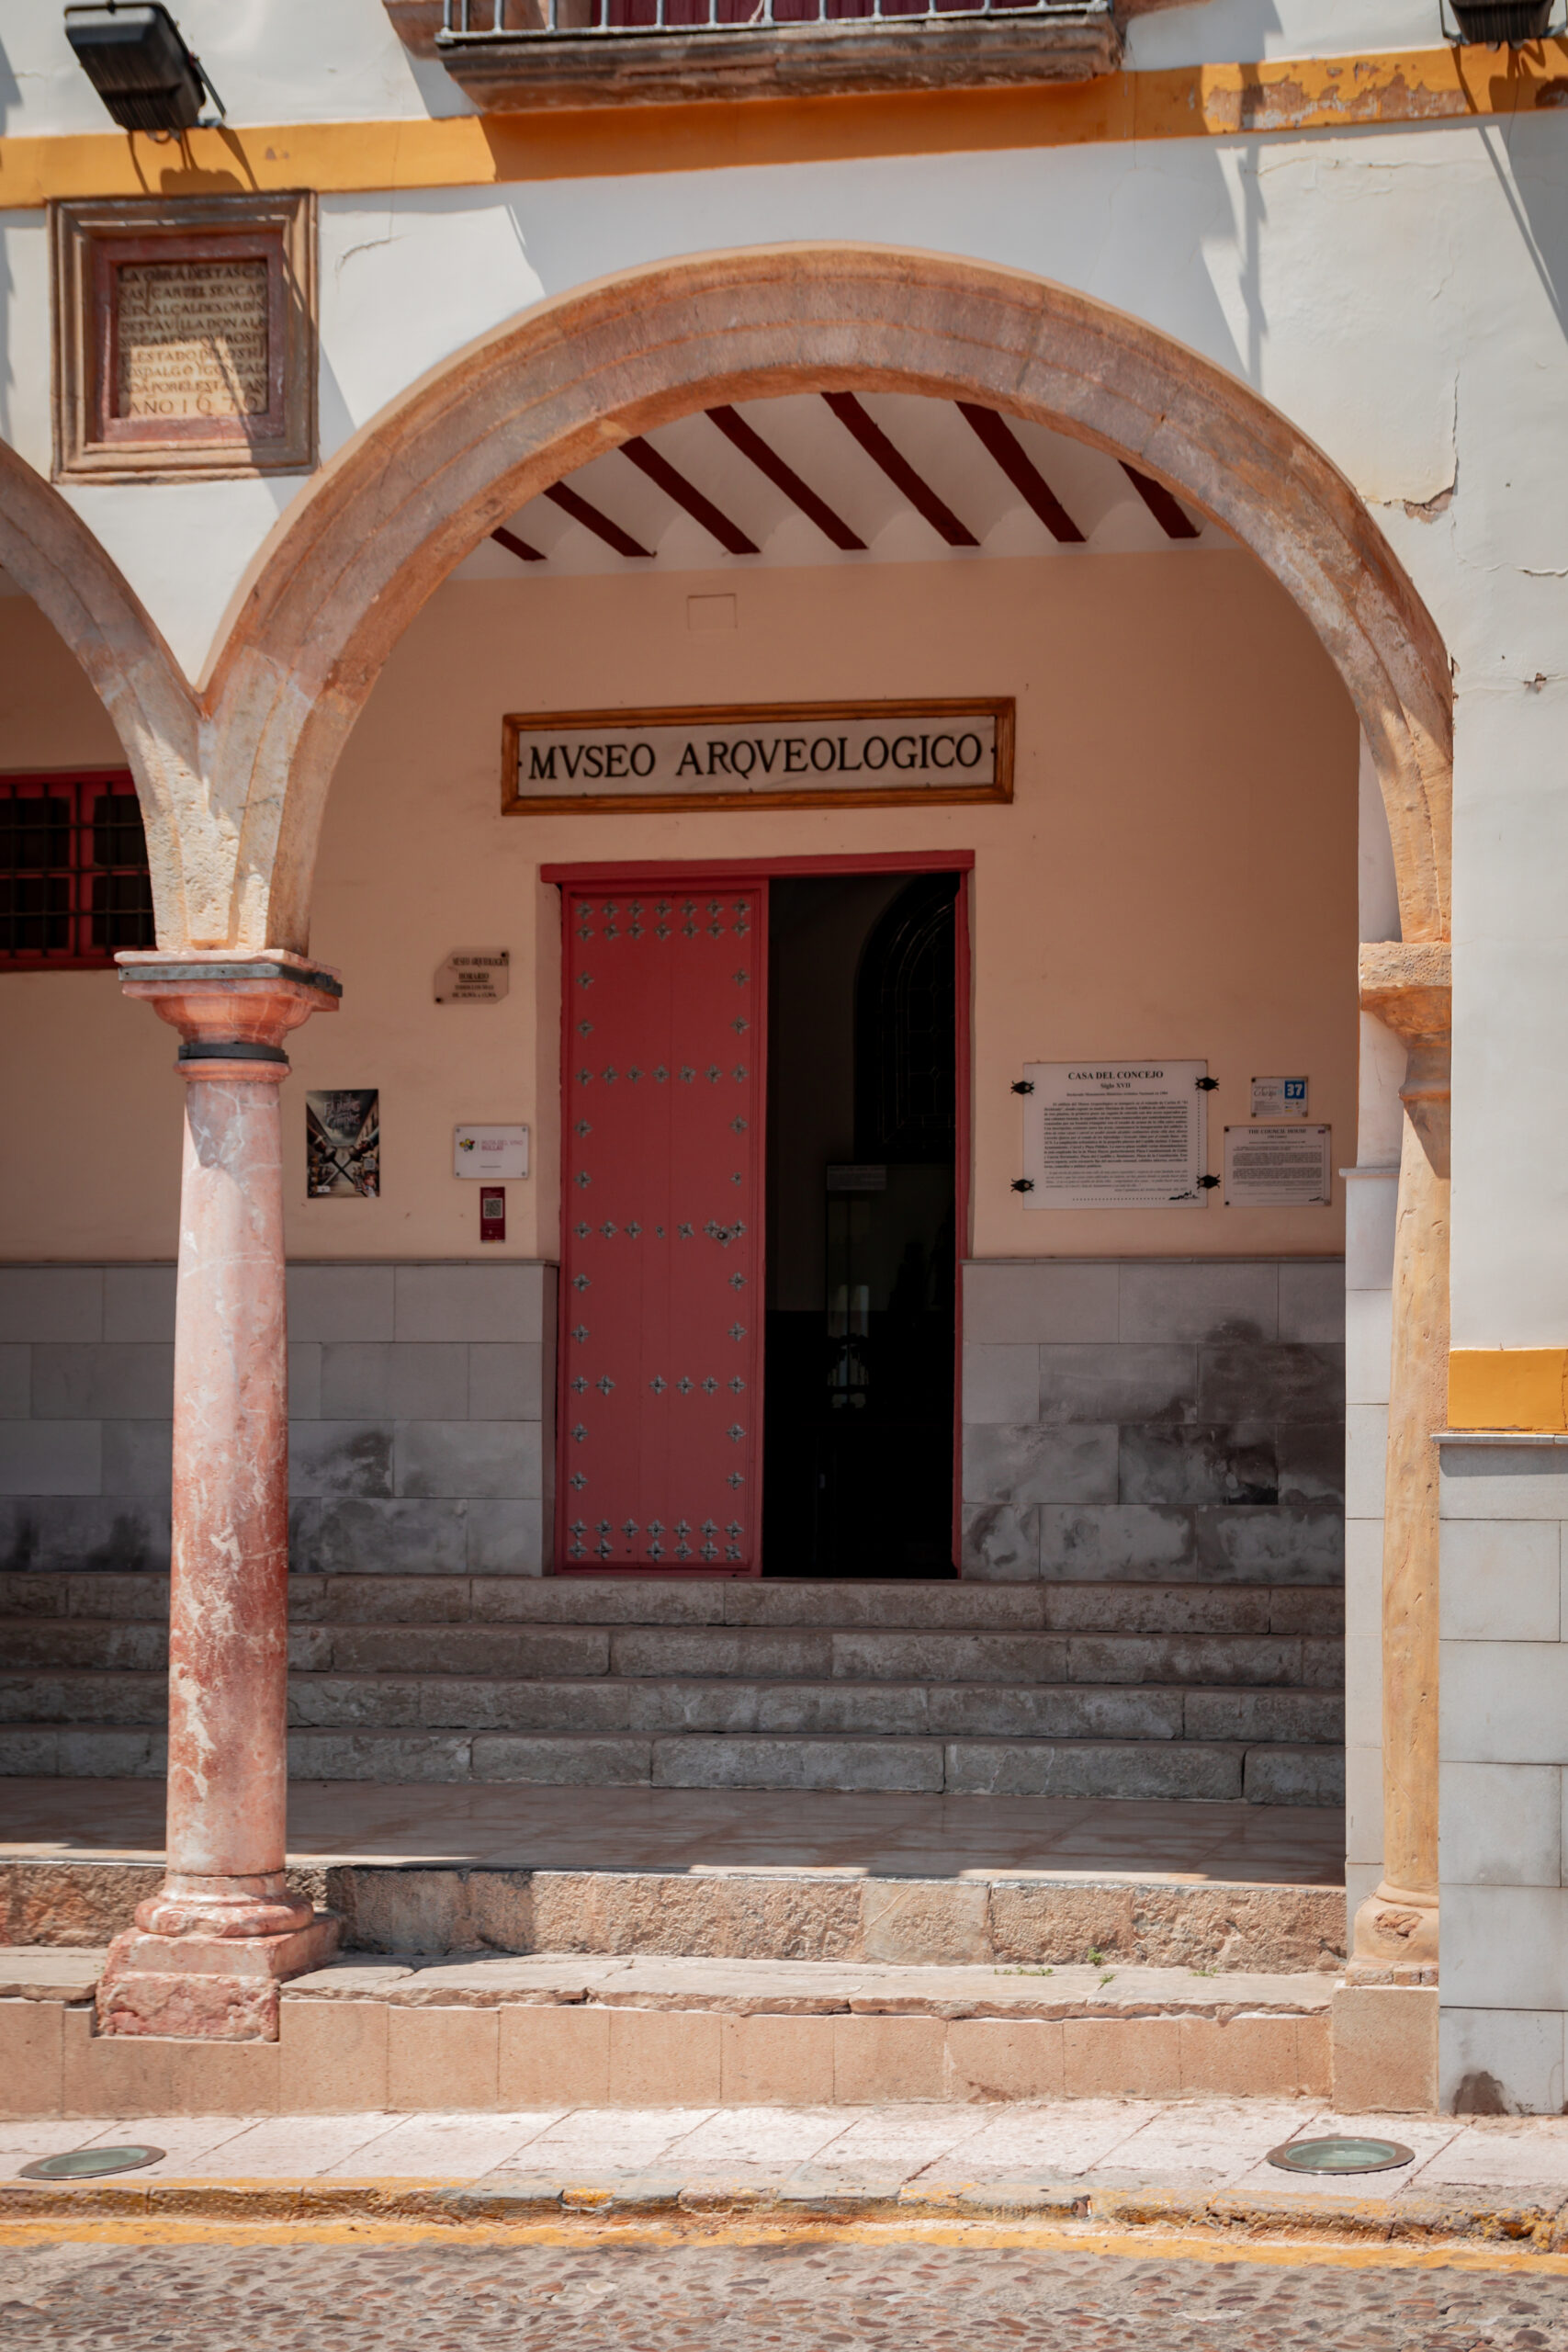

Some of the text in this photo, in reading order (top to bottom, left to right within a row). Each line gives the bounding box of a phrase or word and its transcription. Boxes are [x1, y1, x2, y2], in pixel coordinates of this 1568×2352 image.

[529, 733, 982, 780] MVSEO ARQVEOLOGICO
[1068, 1070, 1164, 1080] CASA DEL CONCEJO
[1286, 1083, 1303, 1097] 37
